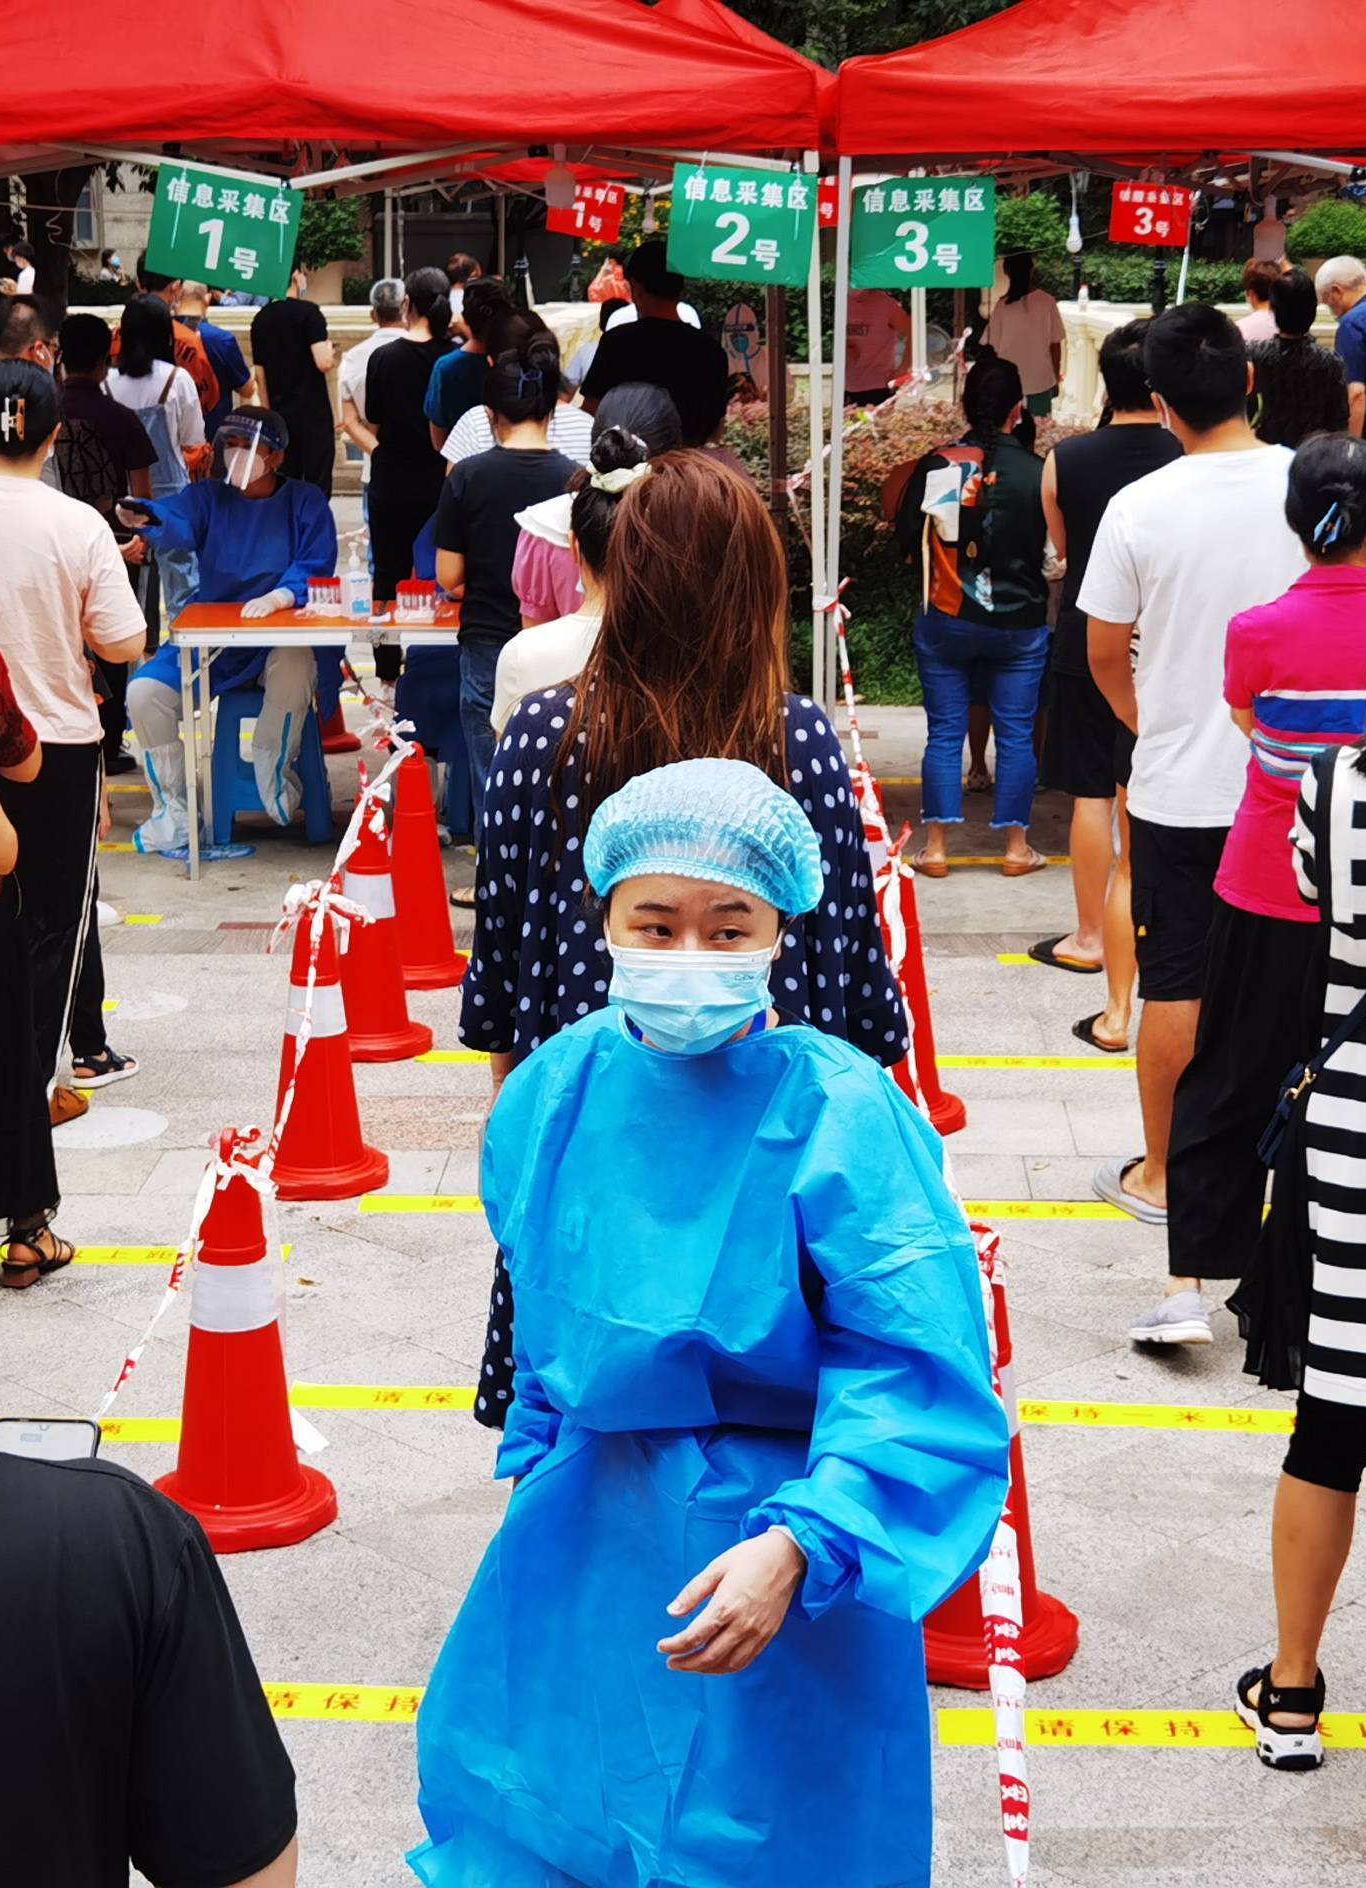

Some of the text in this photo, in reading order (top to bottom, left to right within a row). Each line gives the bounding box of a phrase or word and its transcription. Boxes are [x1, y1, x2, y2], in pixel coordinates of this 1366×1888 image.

[167, 177, 291, 224] 信息采集区
[684, 175, 809, 210] 信息采集区
[862, 187, 985, 213] 信息采集区
[711, 212, 780, 270] 2号
[1134, 207, 1170, 238] 3号
[198, 218, 259, 280] 1号
[894, 220, 962, 274] 3号
